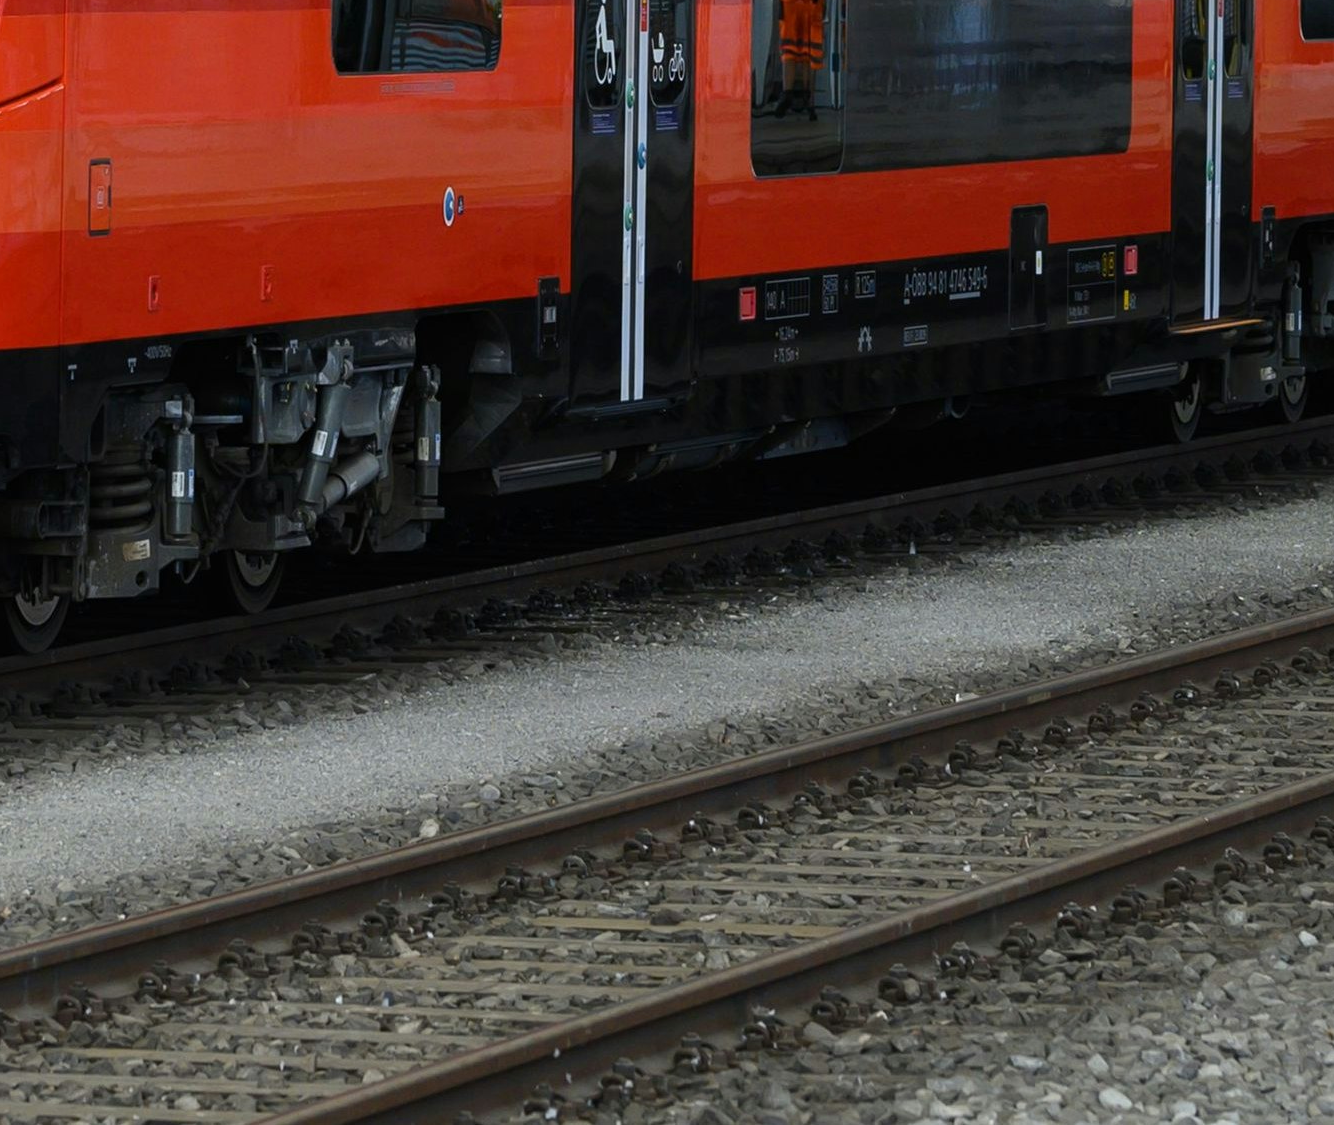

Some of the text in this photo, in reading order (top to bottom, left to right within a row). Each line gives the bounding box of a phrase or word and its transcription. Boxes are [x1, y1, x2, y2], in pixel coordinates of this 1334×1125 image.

[927, 271, 937, 295] 94
[938, 270, 947, 294] 81
[949, 268, 966, 292] 4746
[968, 266, 988, 290] 549-6
